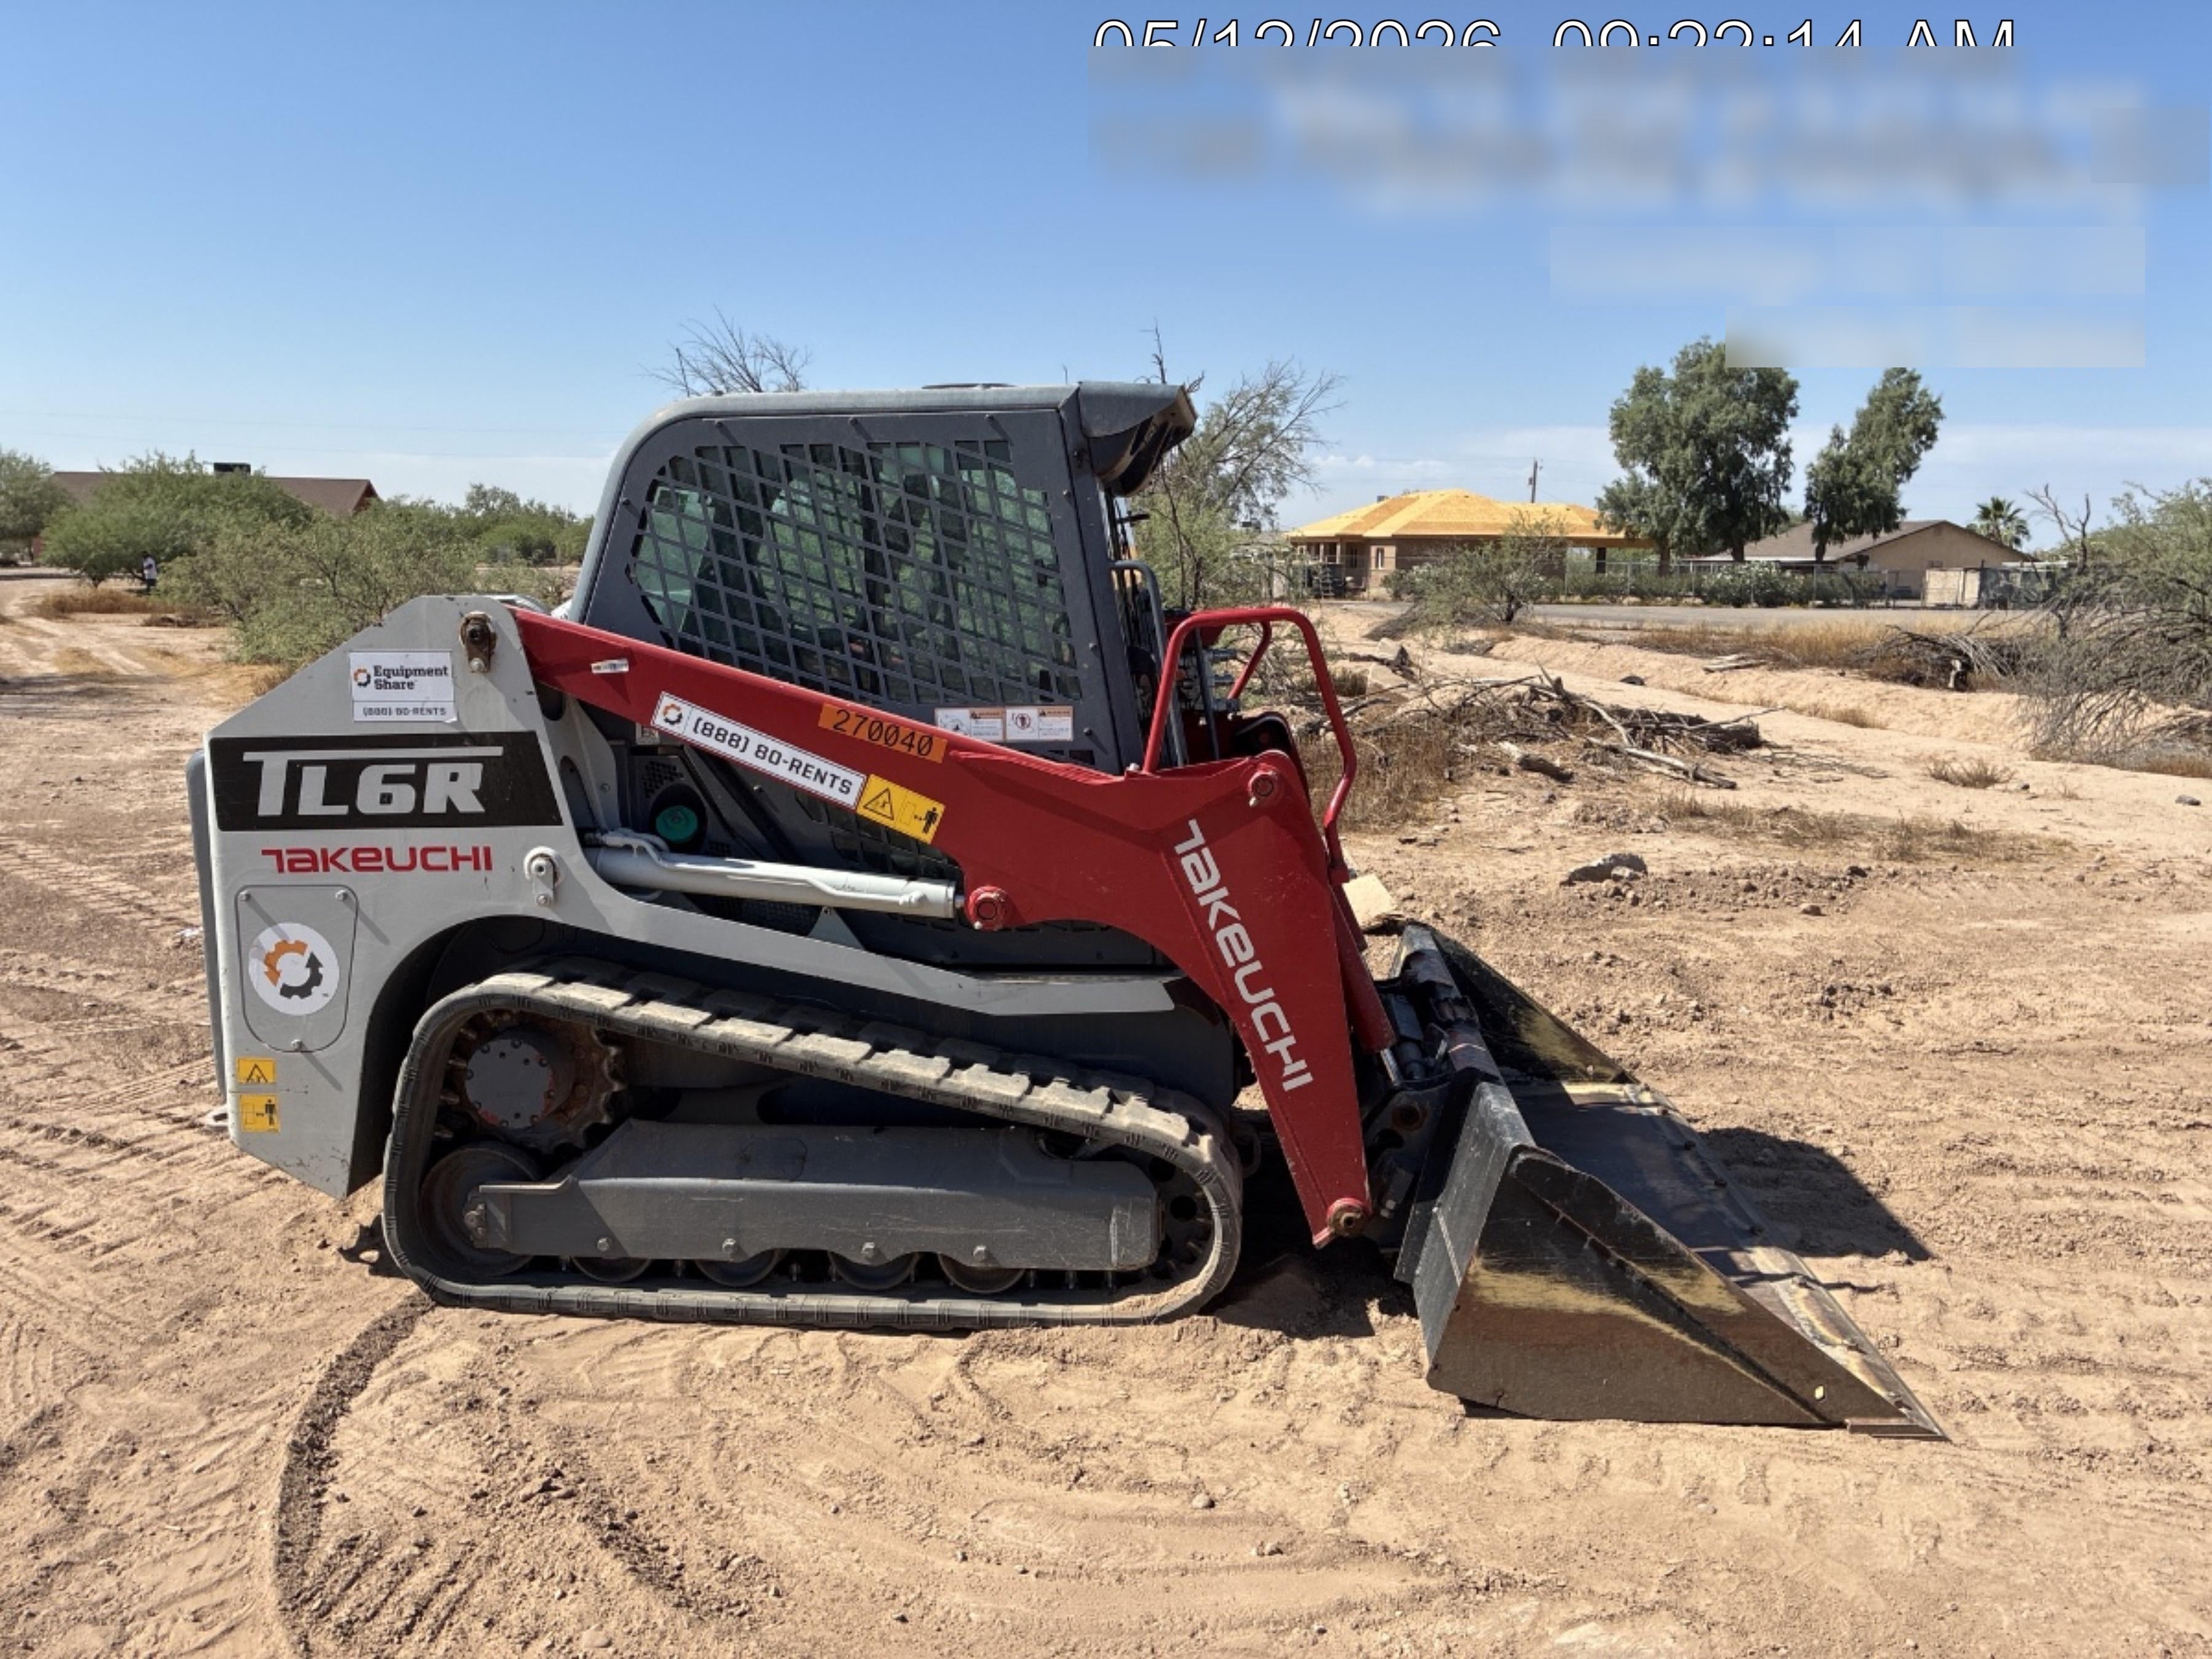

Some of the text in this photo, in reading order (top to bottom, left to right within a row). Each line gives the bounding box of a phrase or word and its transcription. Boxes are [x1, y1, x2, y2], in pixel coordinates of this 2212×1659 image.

[373, 665, 448, 678] Equipment
[374, 678, 415, 690] Share
[692, 716, 853, 795] (888) 80-RENTS
[833, 709, 933, 756] 270040
[243, 747, 503, 817] TL6R
